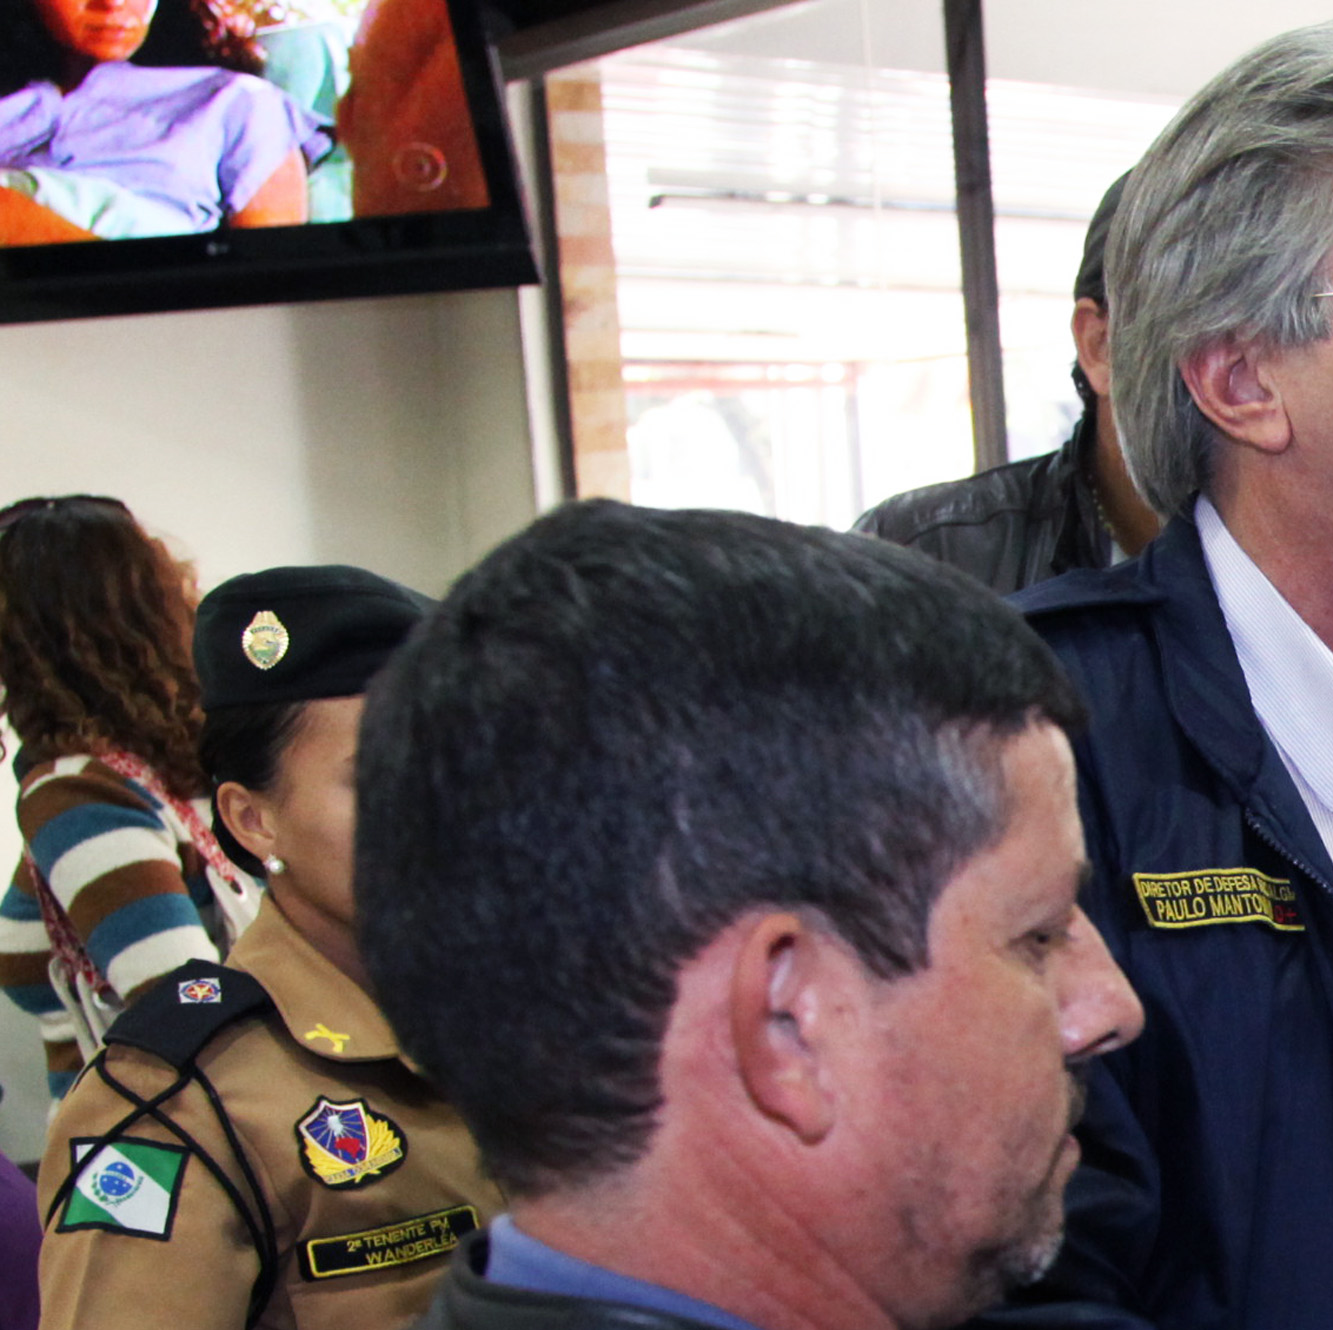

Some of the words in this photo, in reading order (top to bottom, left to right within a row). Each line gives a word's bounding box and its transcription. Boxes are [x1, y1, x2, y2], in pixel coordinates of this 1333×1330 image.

[1140, 879, 1191, 899] DIRETOR
[1193, 876, 1212, 895] DE
[1213, 874, 1259, 893] DEFESA
[1155, 897, 1206, 921] PAULO
[1210, 892, 1274, 919] MANTO
[363, 1223, 427, 1250] TENENTE
